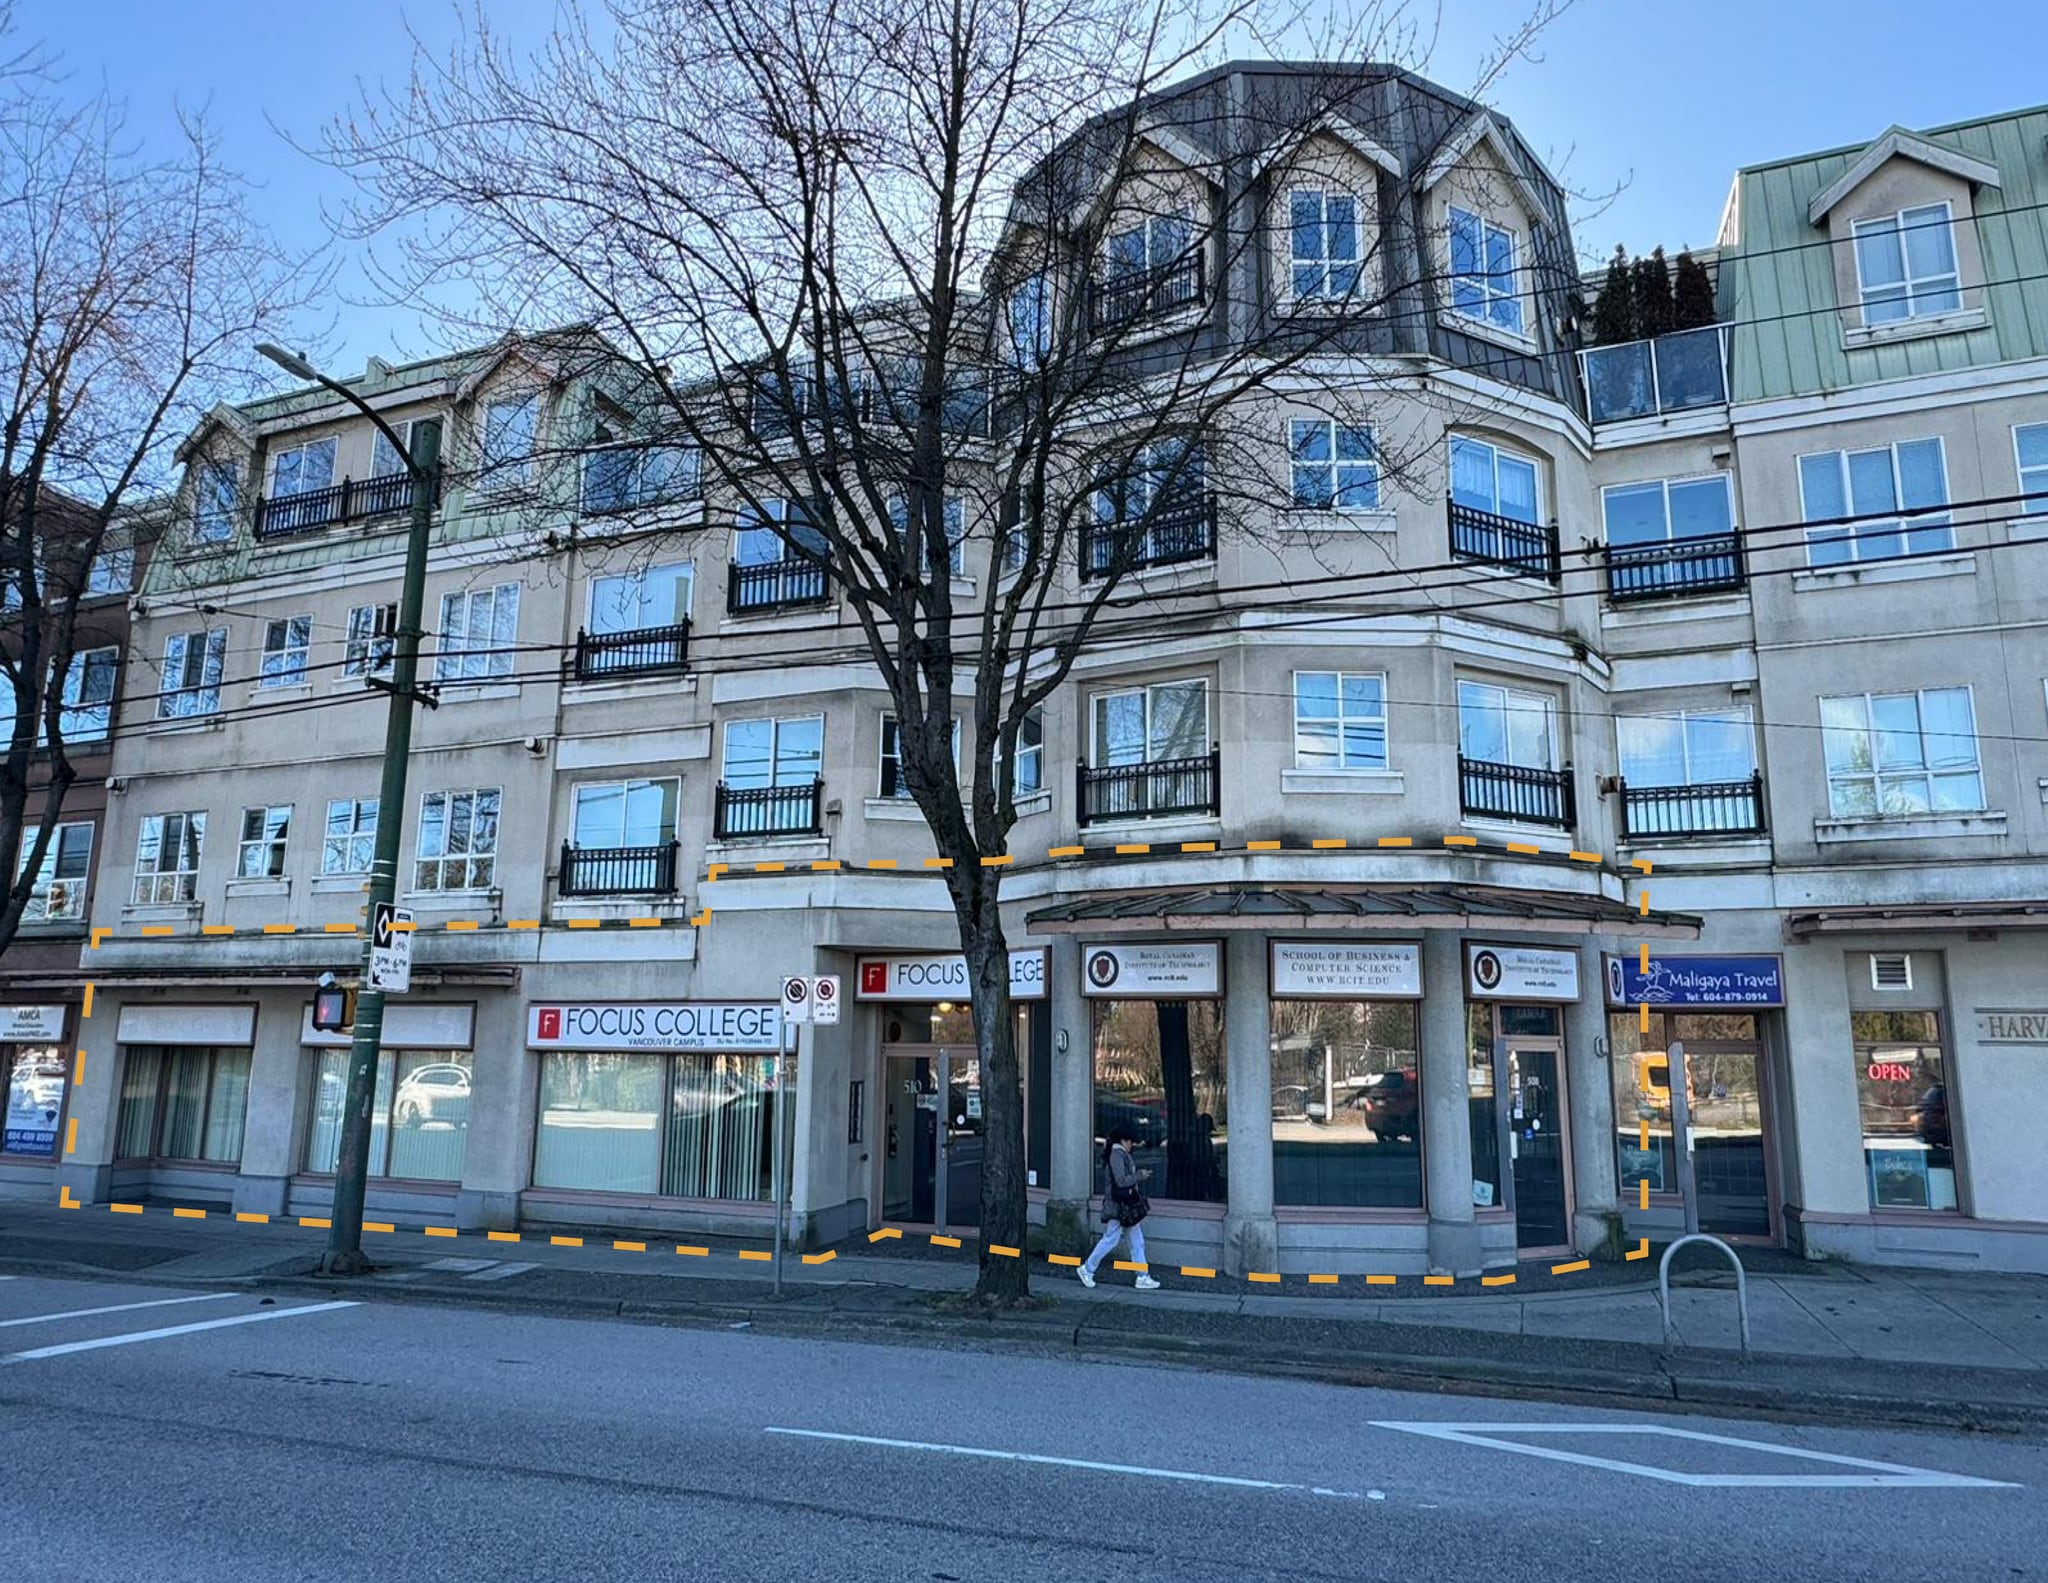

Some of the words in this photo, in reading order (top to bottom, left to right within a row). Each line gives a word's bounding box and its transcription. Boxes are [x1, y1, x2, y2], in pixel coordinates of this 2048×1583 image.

[1282, 951, 1325, 961] SCHOOL
[1346, 951, 1401, 961] BUSINESS
[898, 963, 965, 986] FOCUS
[1291, 962, 1351, 973] COMPUTER
[1355, 963, 1402, 974] SCIENCE
[1669, 970, 1731, 991] Maligaya
[1734, 970, 1778, 988] Travel
[1703, 992, 1768, 1001] 604-879-0914
[18, 1009, 41, 1021] AMCA
[566, 1008, 645, 1036] FOCUS
[654, 1008, 774, 1036] COLLEGE
[1987, 1015, 2048, 1039] HARV
[627, 1038, 672, 1047] VANCOUVER
[673, 1038, 705, 1047] CAMPUS
[1868, 1063, 1911, 1081] OPEN
